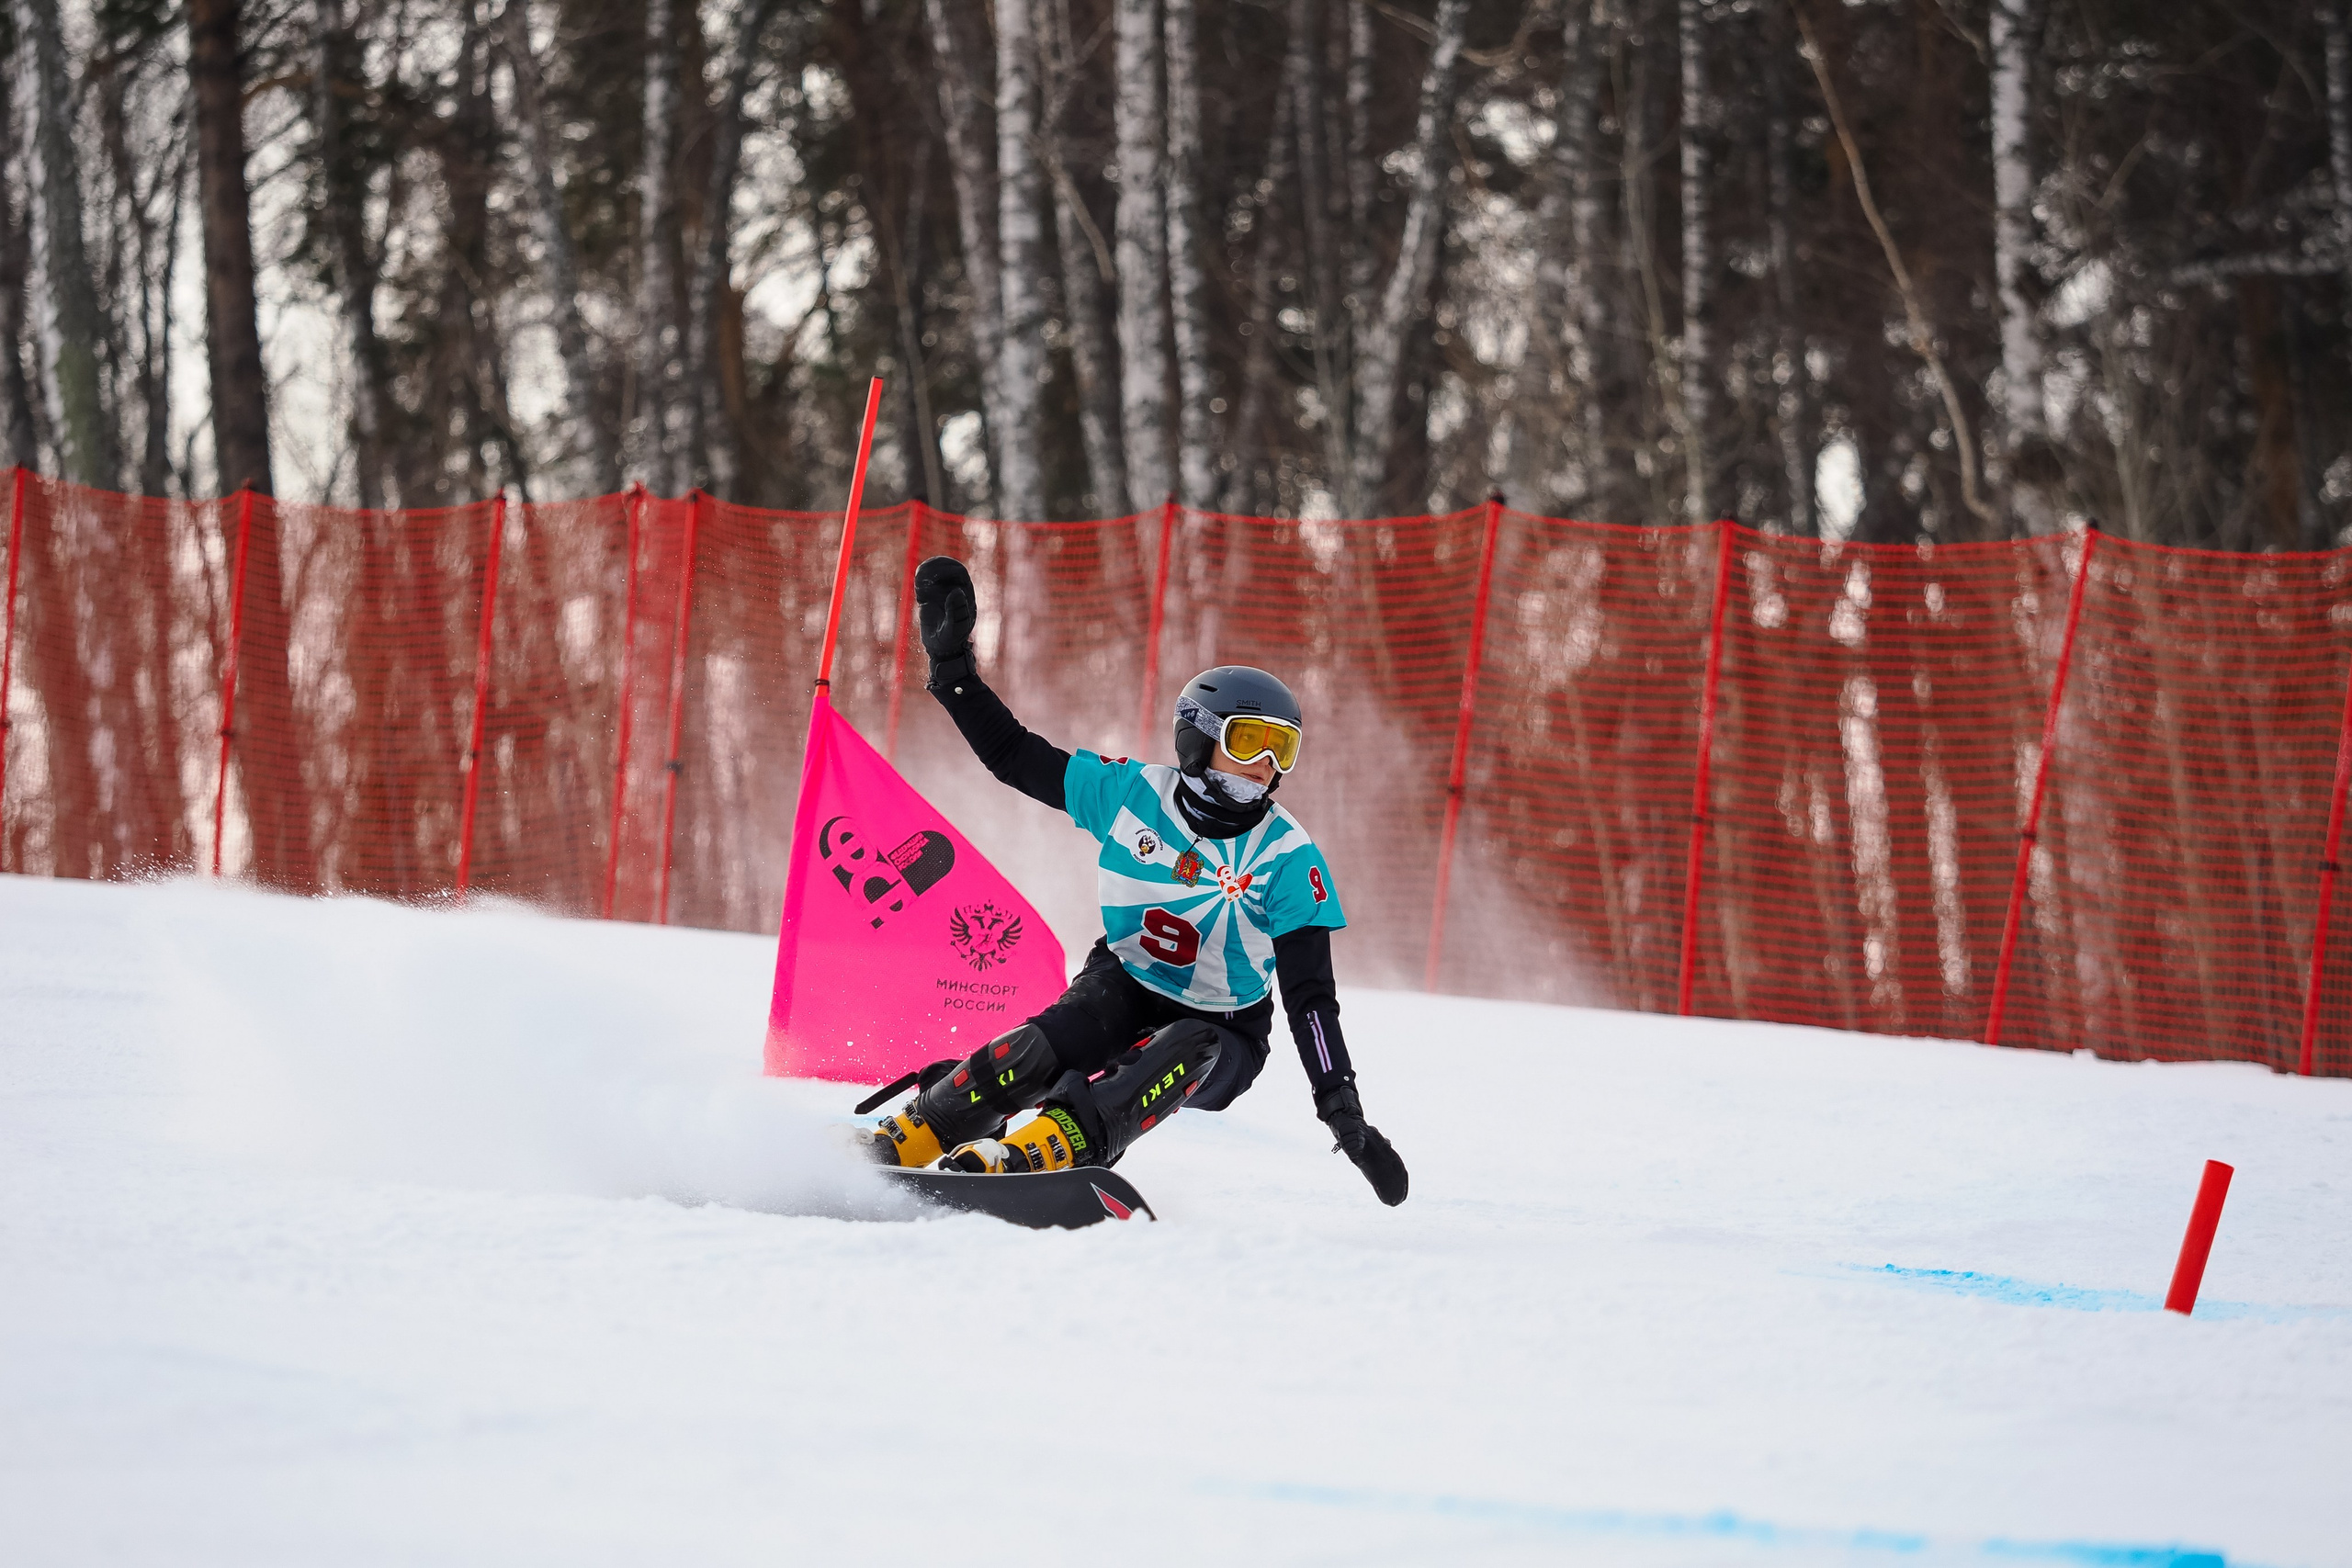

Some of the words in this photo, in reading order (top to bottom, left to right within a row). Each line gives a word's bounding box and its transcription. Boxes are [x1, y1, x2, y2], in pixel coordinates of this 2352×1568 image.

[1308, 865, 1329, 904] 9
[1139, 907, 1202, 967] 9
[936, 978, 1019, 996] МИНСПОРТ
[944, 998, 1006, 1012] РОССИИ
[970, 1068, 1014, 1103] LKI
[1141, 1063, 1185, 1108] LEKI
[1046, 1108, 1087, 1151] BOOSTER
